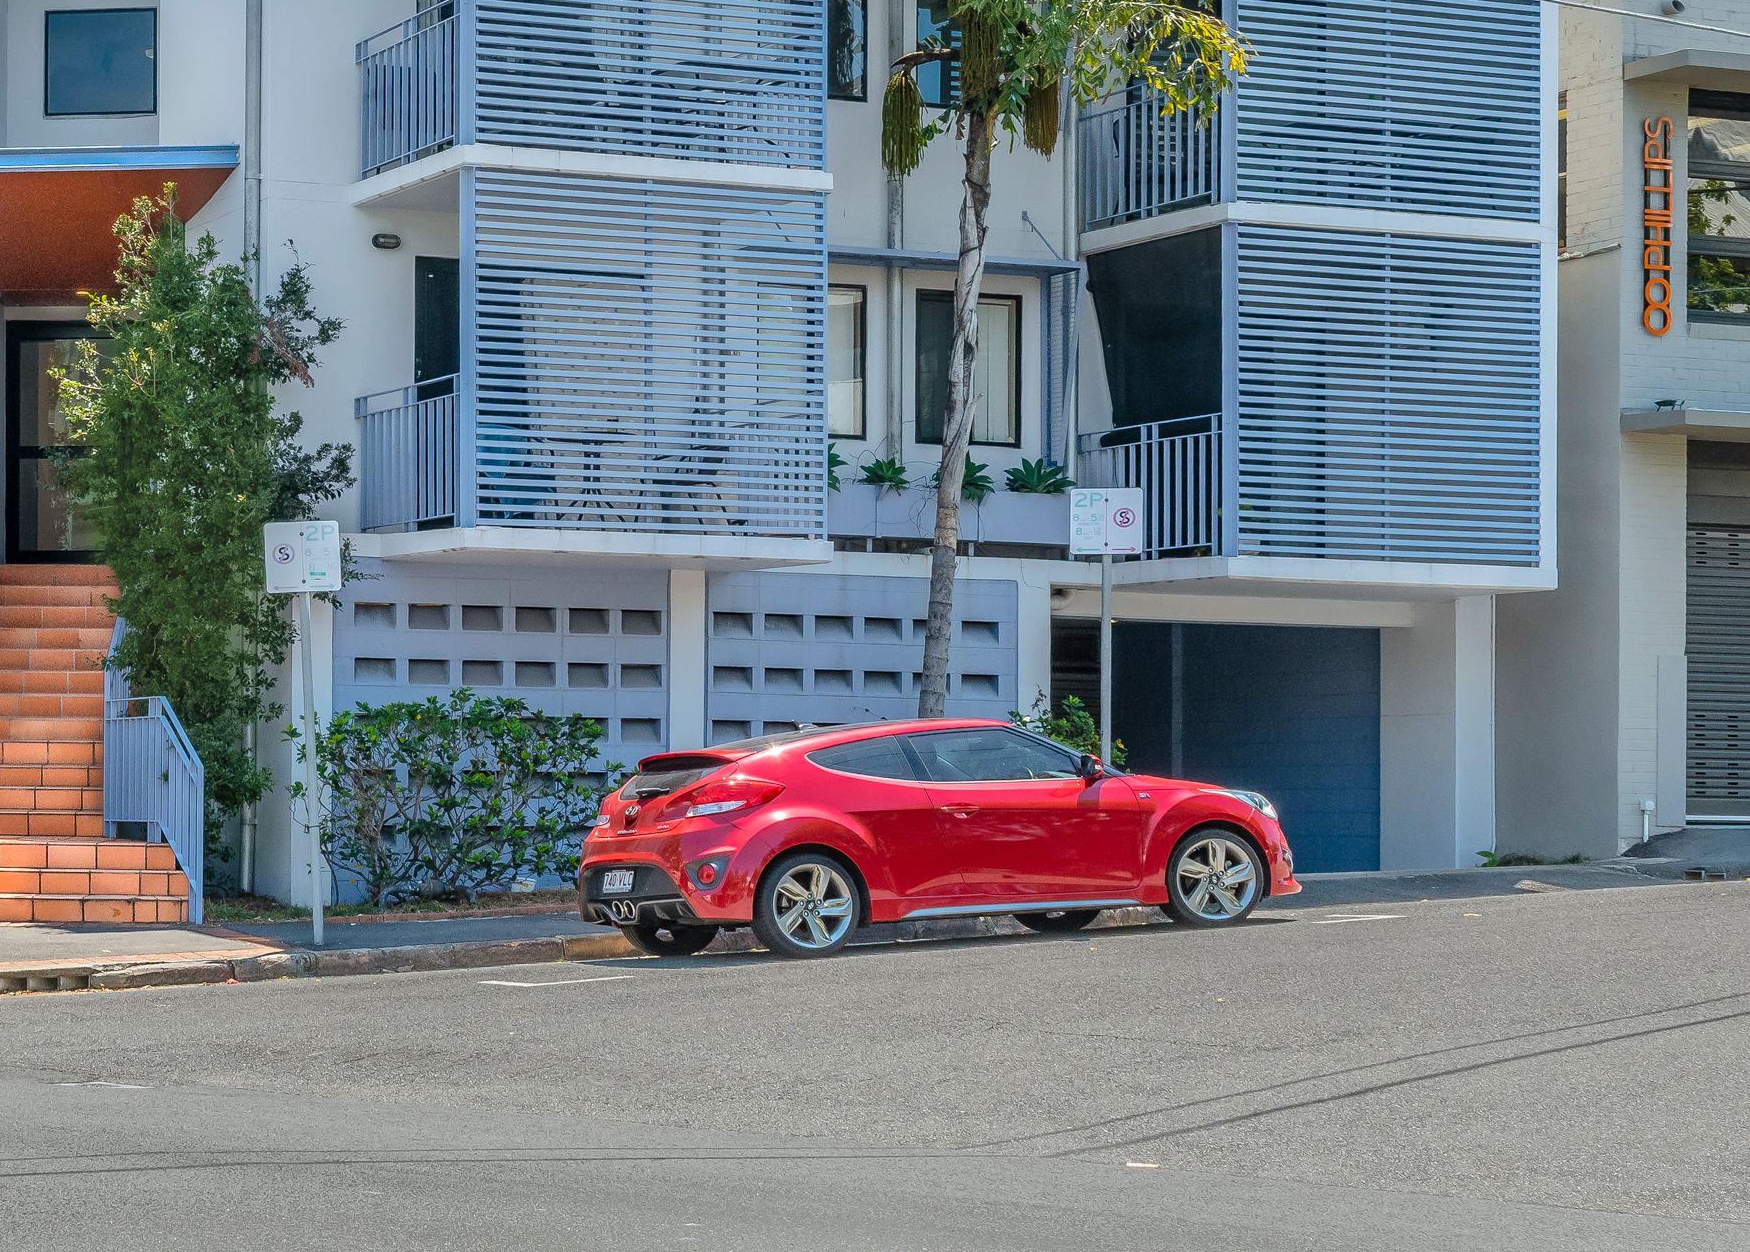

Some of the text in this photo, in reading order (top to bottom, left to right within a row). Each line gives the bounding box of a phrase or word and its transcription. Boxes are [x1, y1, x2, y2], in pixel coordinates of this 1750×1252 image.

[1643, 115, 1674, 270] PHILLIPS
[1074, 492, 1104, 508] 2P
[305, 524, 335, 542] 2P
